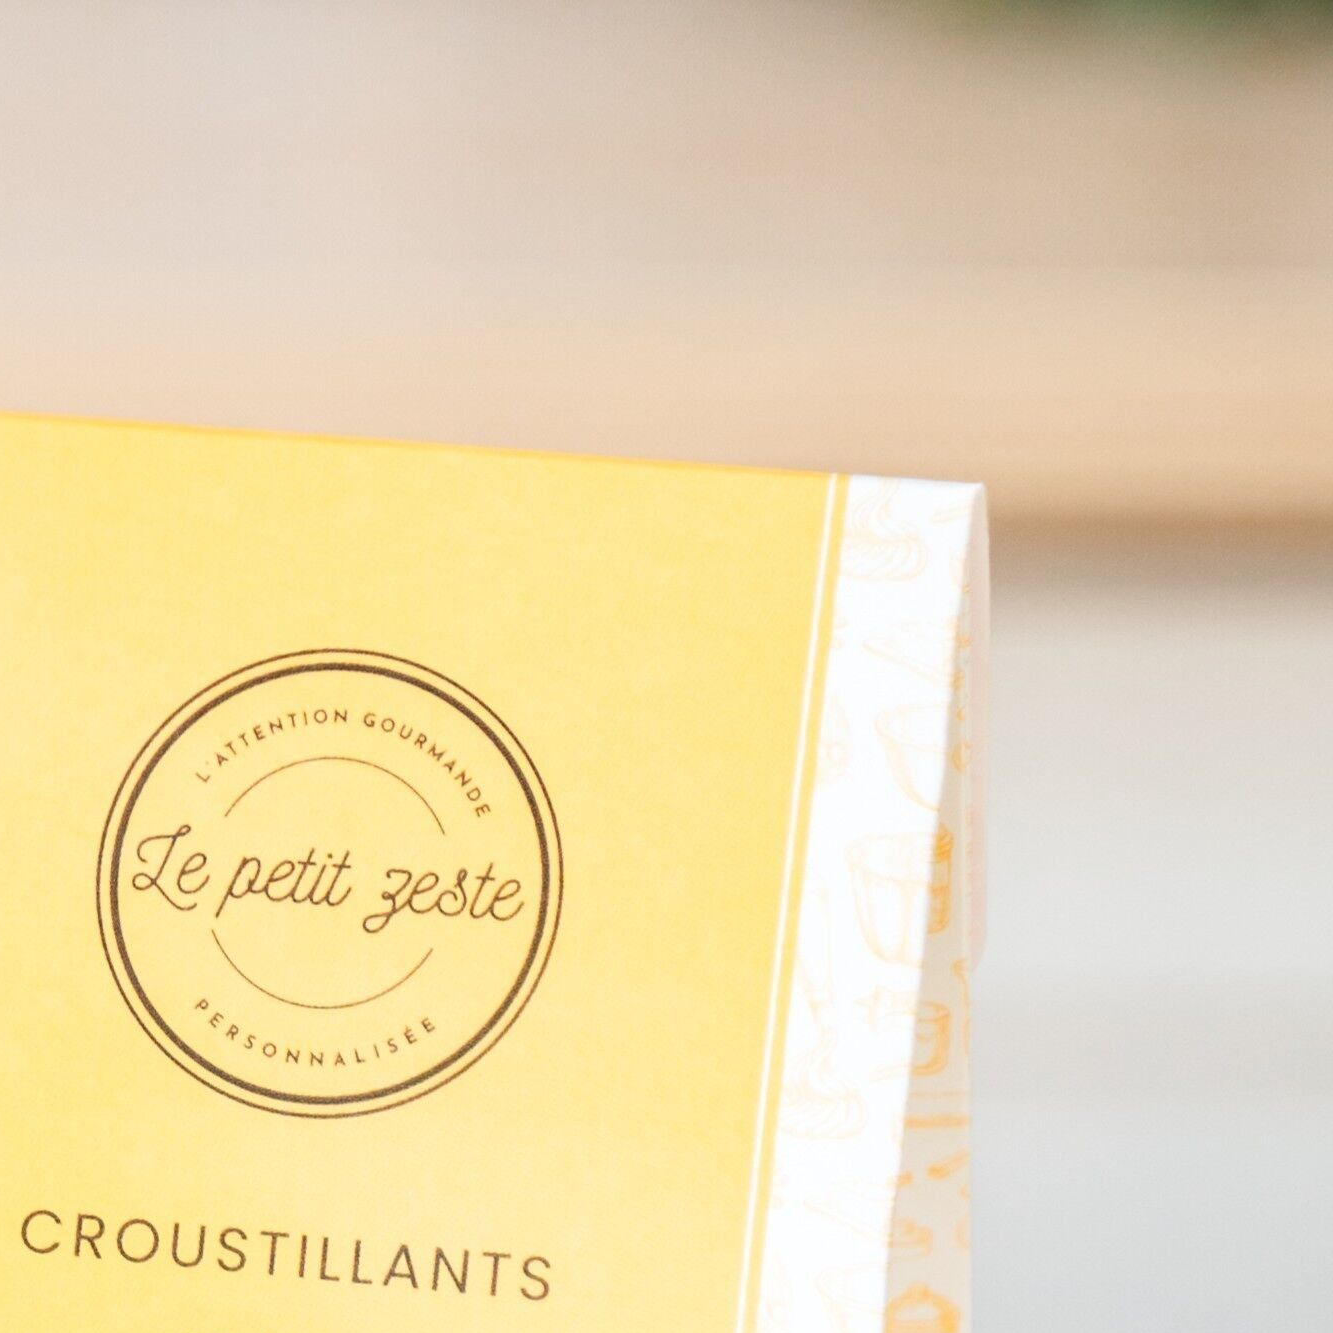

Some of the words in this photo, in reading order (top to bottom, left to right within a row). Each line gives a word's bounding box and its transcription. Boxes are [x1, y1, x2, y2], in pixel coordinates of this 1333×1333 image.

[195, 708, 348, 783] L'ATTENTION
[363, 712, 491, 818] GOURMANDE
[132, 825, 210, 911] Le
[215, 847, 352, 919] petit
[362, 862, 525, 934] zeste
[194, 998, 436, 1067] PERSONNALISÉE
[21, 1210, 551, 1300] CROUSTILLANTS
